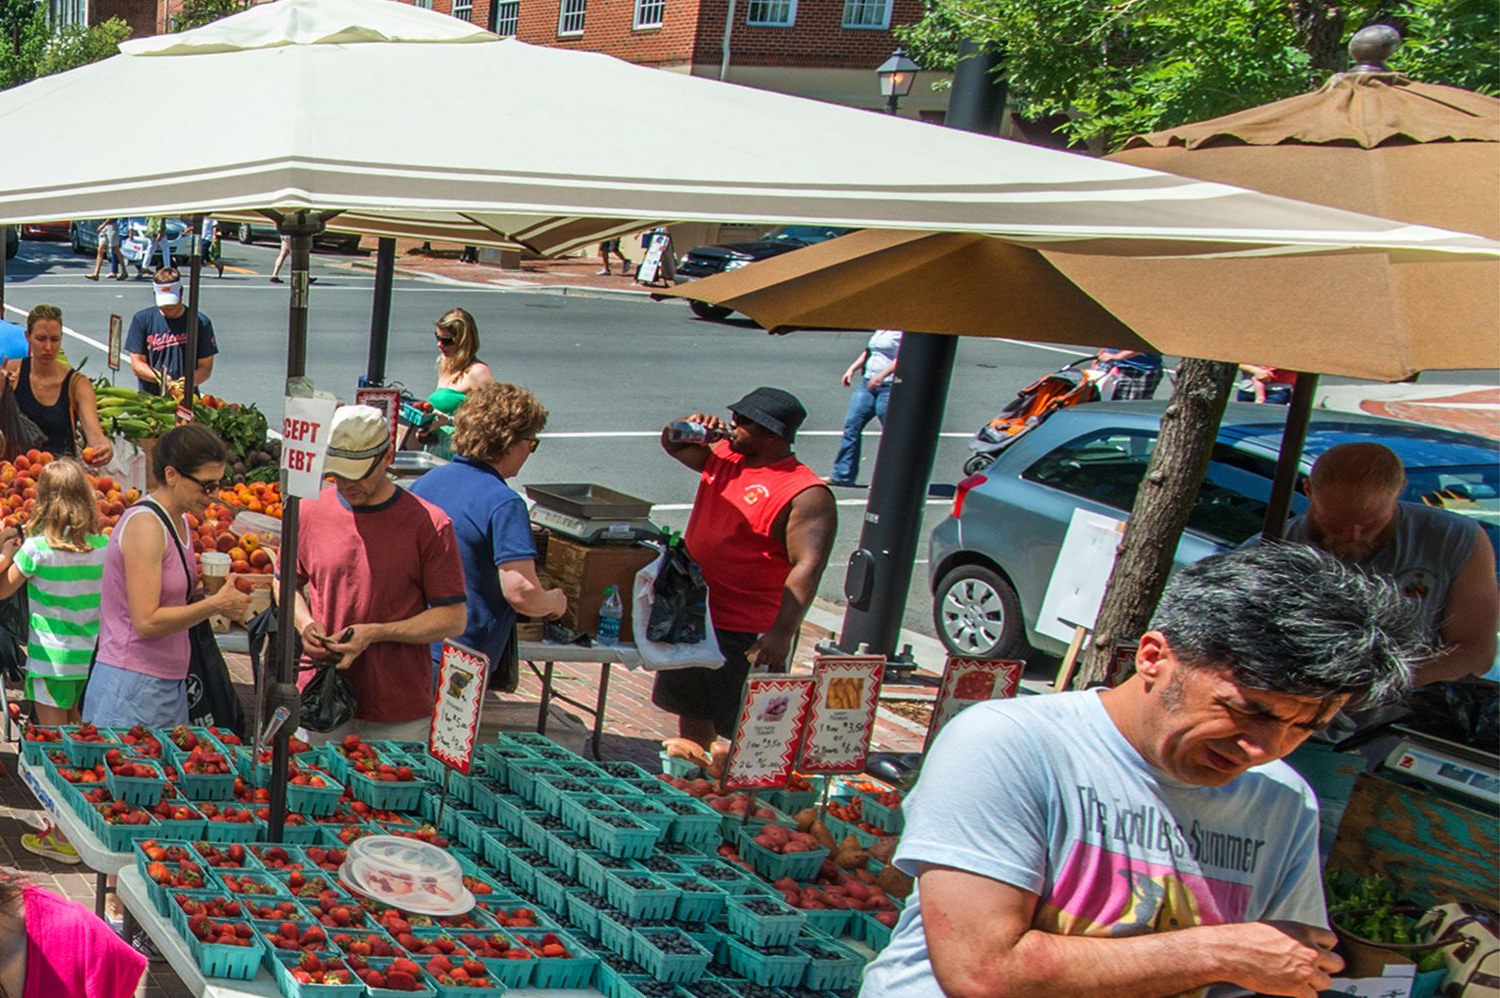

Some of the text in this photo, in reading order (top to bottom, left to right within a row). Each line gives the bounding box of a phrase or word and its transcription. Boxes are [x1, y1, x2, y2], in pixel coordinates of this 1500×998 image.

[284, 418, 320, 443] CEPT
[288, 451, 316, 473] EBT
[1077, 785, 1266, 874] The Endles Summer
